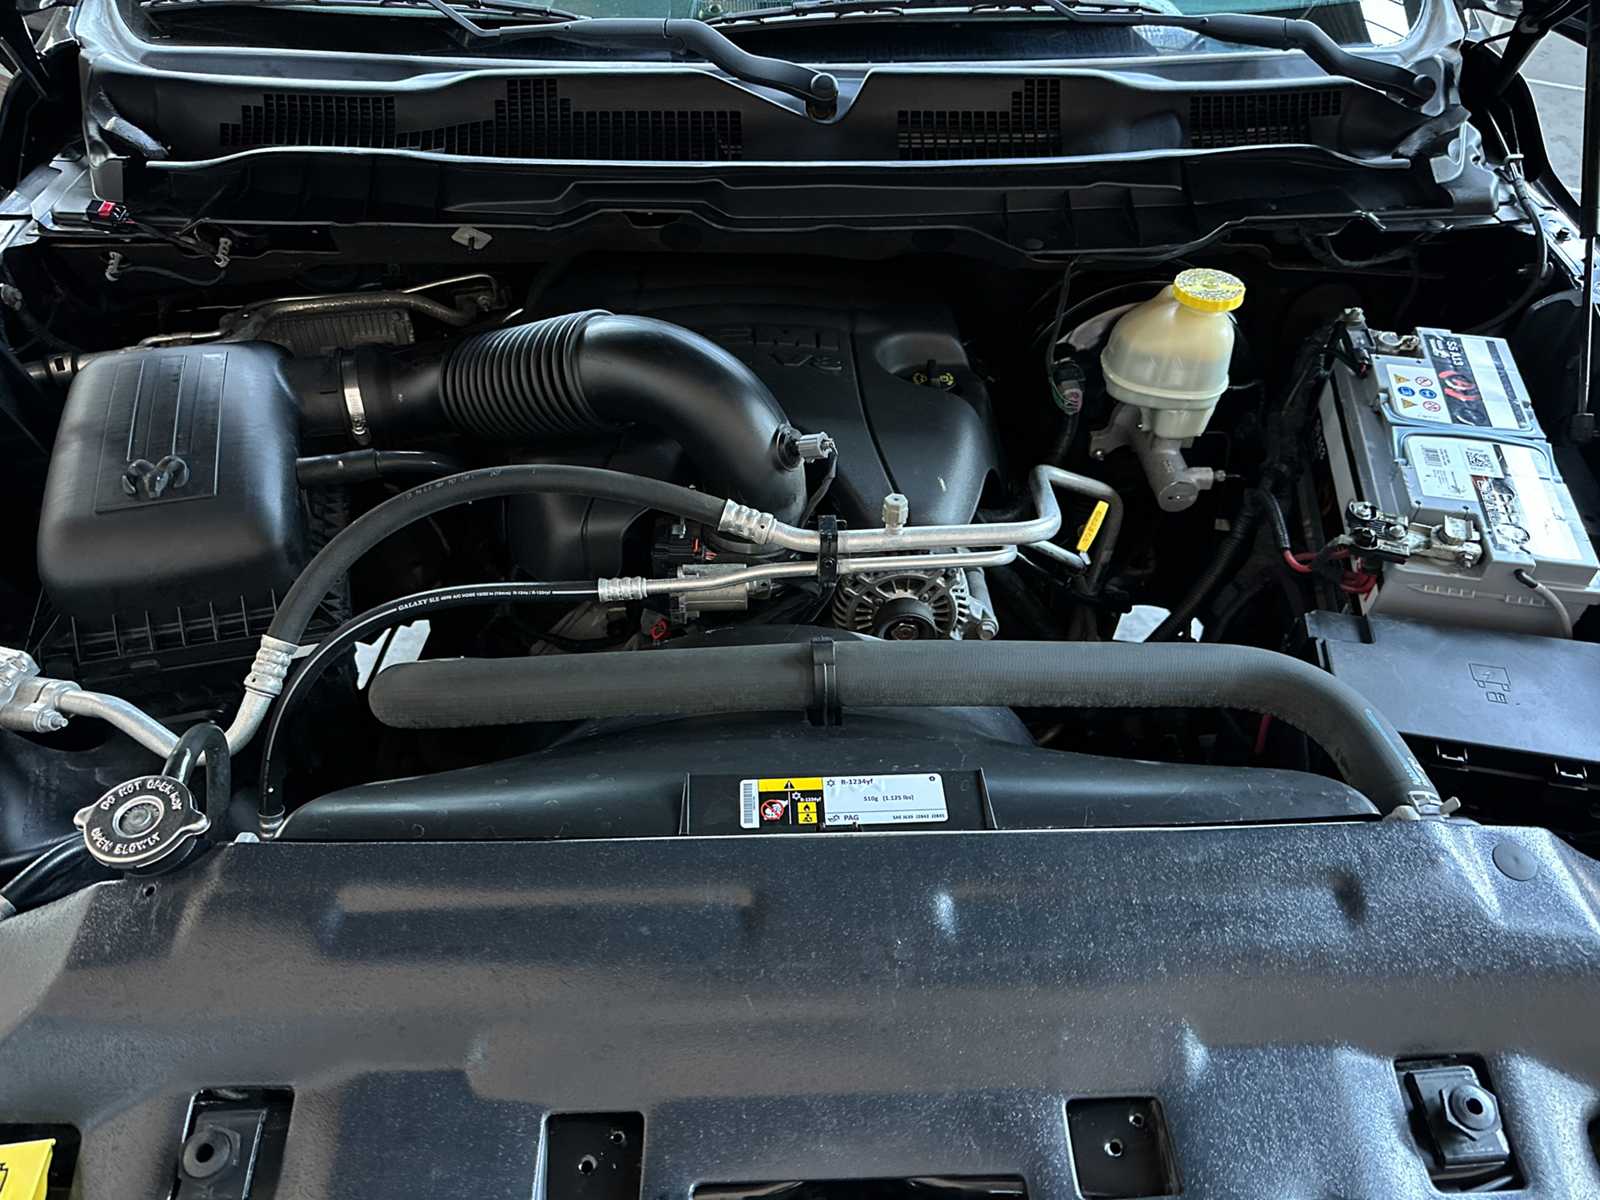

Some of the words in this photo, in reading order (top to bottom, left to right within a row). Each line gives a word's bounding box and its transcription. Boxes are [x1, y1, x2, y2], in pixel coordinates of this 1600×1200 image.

[399, 599, 429, 611] GALAXY
[100, 795, 116, 811] DO
[118, 781, 143, 797] NOT
[146, 779, 175, 795] OPEN
[90, 826, 114, 852] OPEN
[113, 831, 161, 855] SLOWLY
